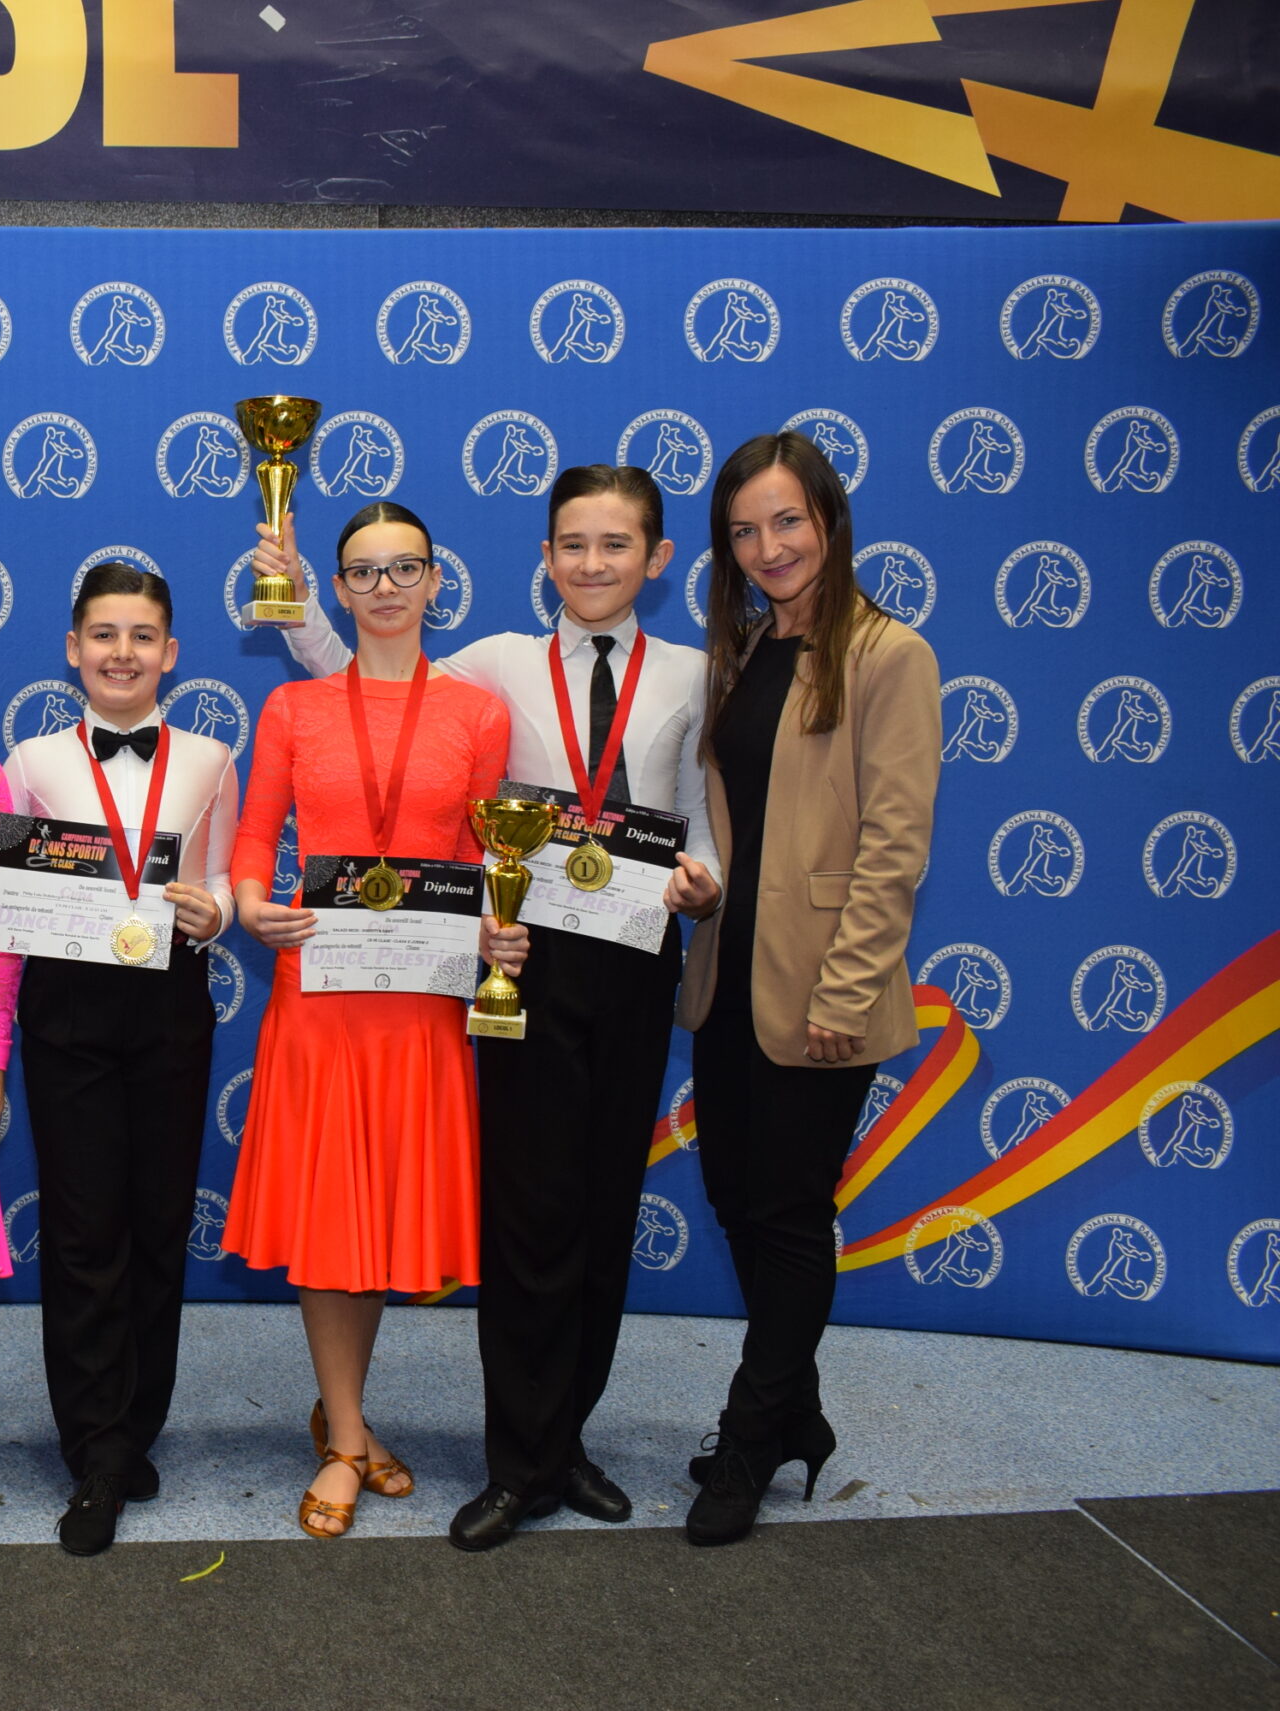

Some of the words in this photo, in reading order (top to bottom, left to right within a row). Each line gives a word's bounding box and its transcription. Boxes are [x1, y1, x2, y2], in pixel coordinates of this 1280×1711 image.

[430, 283, 443, 292] DE
[444, 289, 464, 311] DANS
[739, 281, 751, 290] DE
[753, 287, 773, 309] DANS
[1059, 277, 1073, 286] DE
[1074, 283, 1095, 305] DANS
[57, 415, 70, 424] DE
[71, 421, 91, 444] DANS
[518, 412, 530, 422] DE
[531, 419, 552, 442] DANS
[985, 410, 997, 419] DE
[998, 416, 1018, 439] DANS
[1052, 544, 1064, 553] DE
[1065, 550, 1085, 573] DANS
[1133, 678, 1145, 688] DE
[1146, 685, 1166, 708] DANS
[626, 828, 676, 848] Diplomă
[1045, 813, 1058, 822] DE
[1058, 819, 1078, 842] DANS
[67, 843, 107, 862] SPORTIV
[581, 862, 588, 878] 1
[374, 882, 381, 898] 1
[424, 881, 474, 896] Diplomă
[1127, 948, 1140, 958] DE
[1140, 955, 1160, 978] DANS
[1124, 1217, 1138, 1227] DE
[1139, 1225, 1160, 1248] DANS
